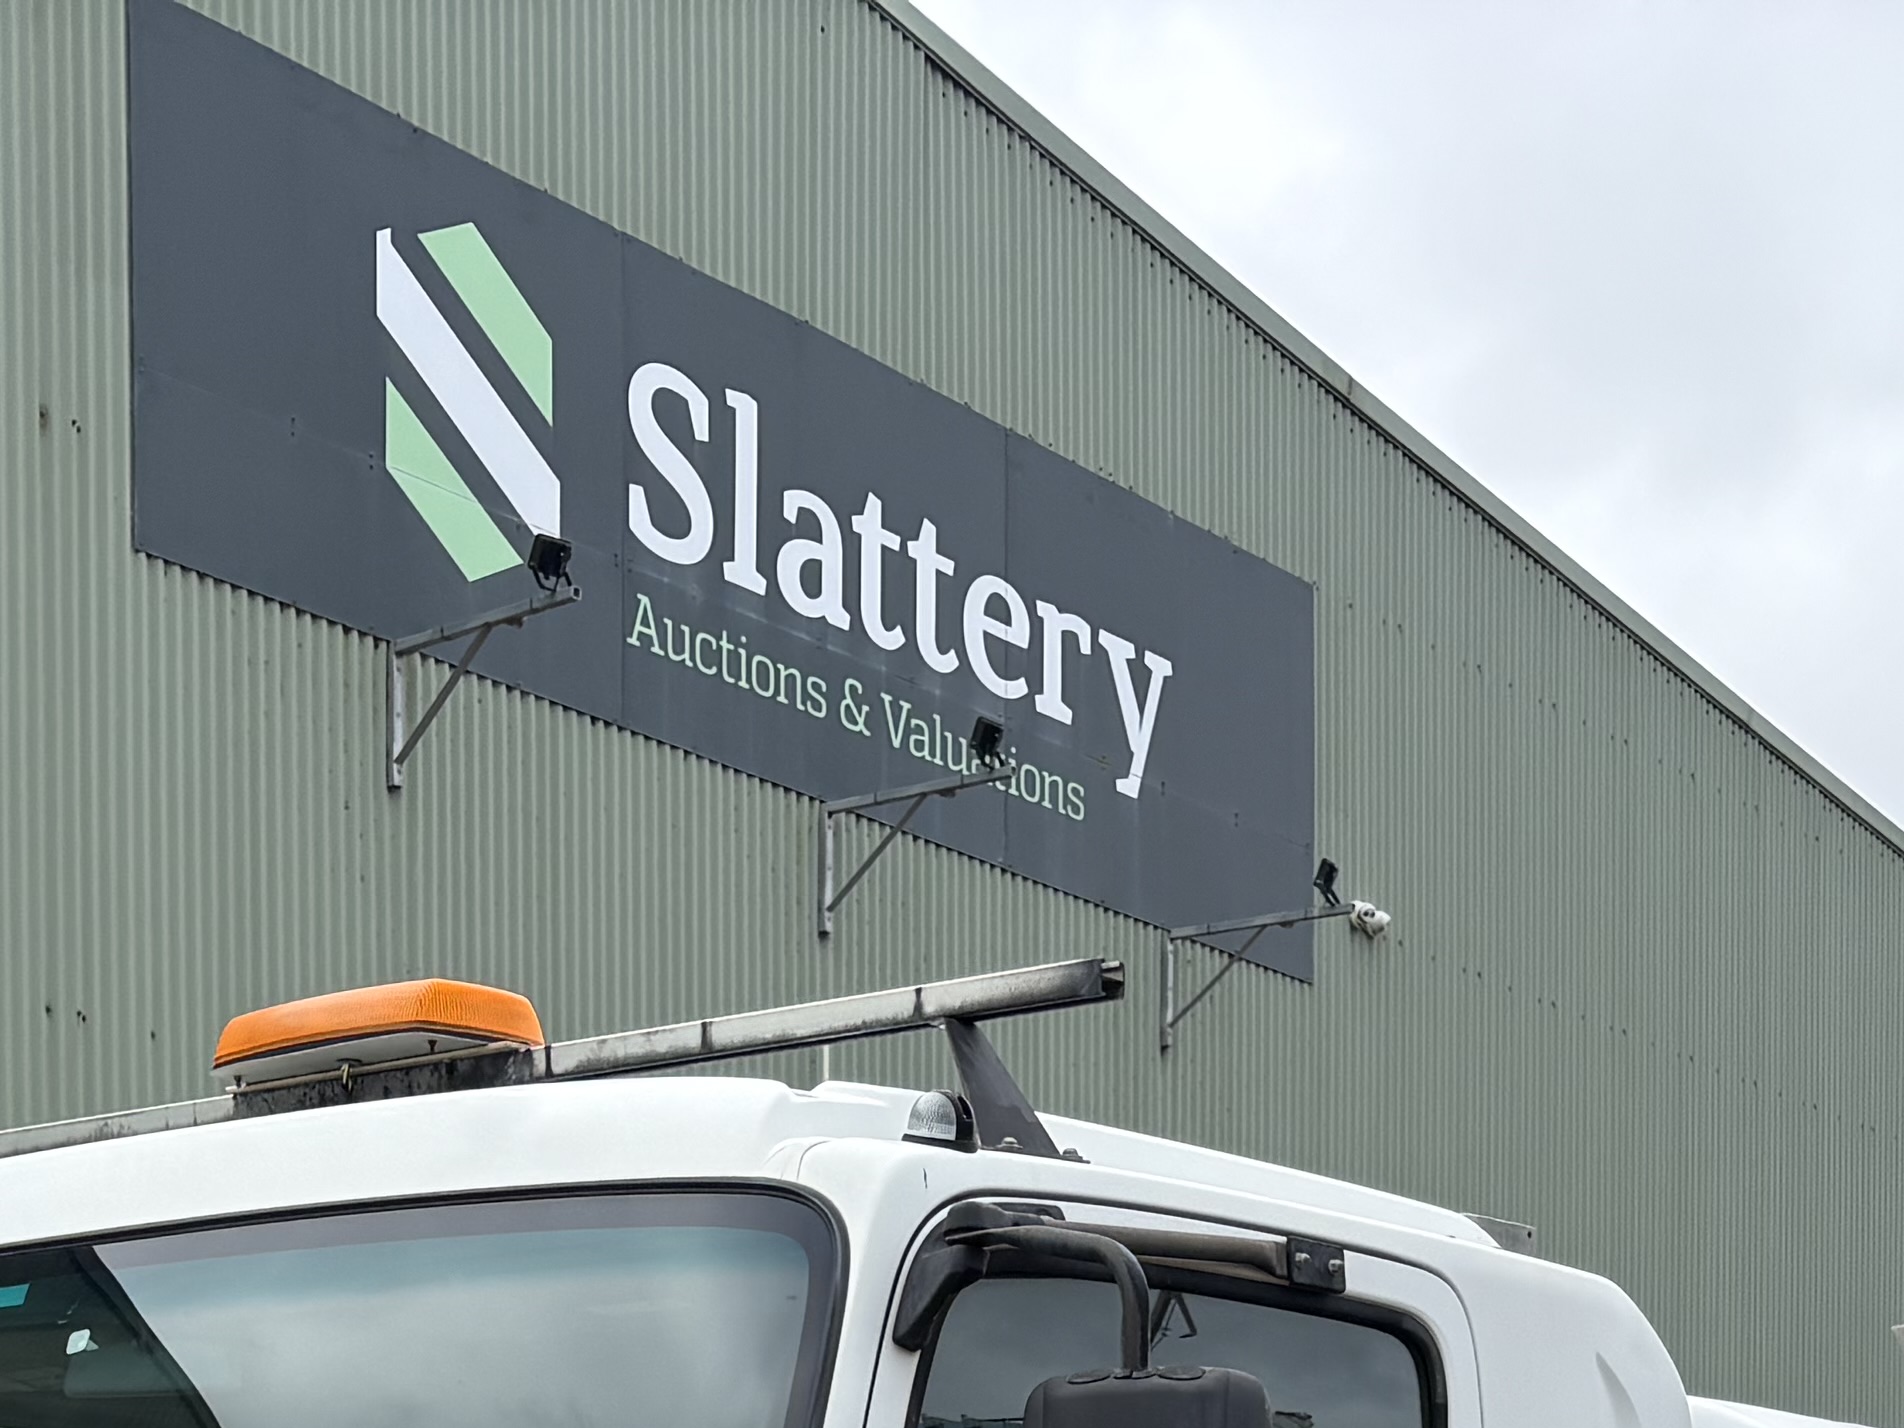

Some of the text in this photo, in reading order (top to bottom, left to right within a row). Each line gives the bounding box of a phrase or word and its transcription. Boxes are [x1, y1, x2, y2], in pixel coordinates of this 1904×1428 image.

[626, 593, 1086, 821] Auctions & Valuions
[627, 361, 1174, 800] Slattery
